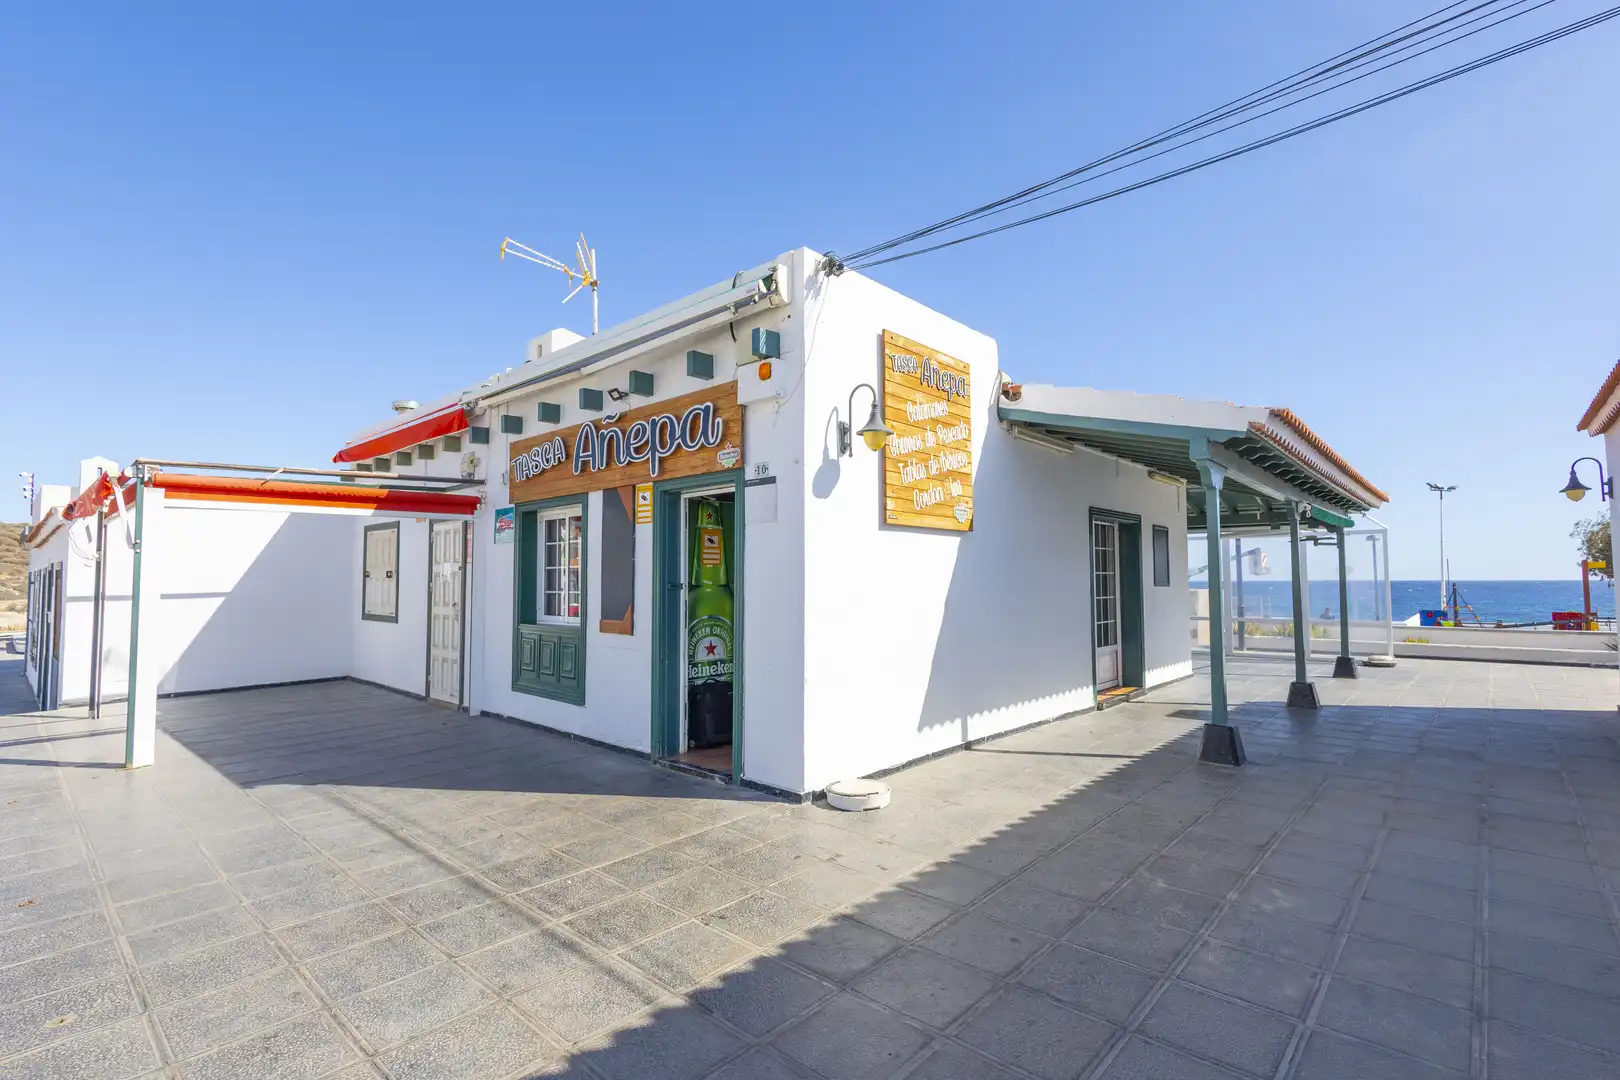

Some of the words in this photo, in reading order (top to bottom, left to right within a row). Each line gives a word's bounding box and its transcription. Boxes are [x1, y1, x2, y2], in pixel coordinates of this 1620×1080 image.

[891, 355, 918, 372] TASCA
[511, 435, 566, 482] TASCA
[573, 402, 723, 477] Añepa
[925, 425, 936, 447] de
[898, 457, 926, 485] Tablas
[929, 454, 940, 476] de
[913, 482, 944, 511] Cordon
[688, 626, 711, 655] HEINEKEN
